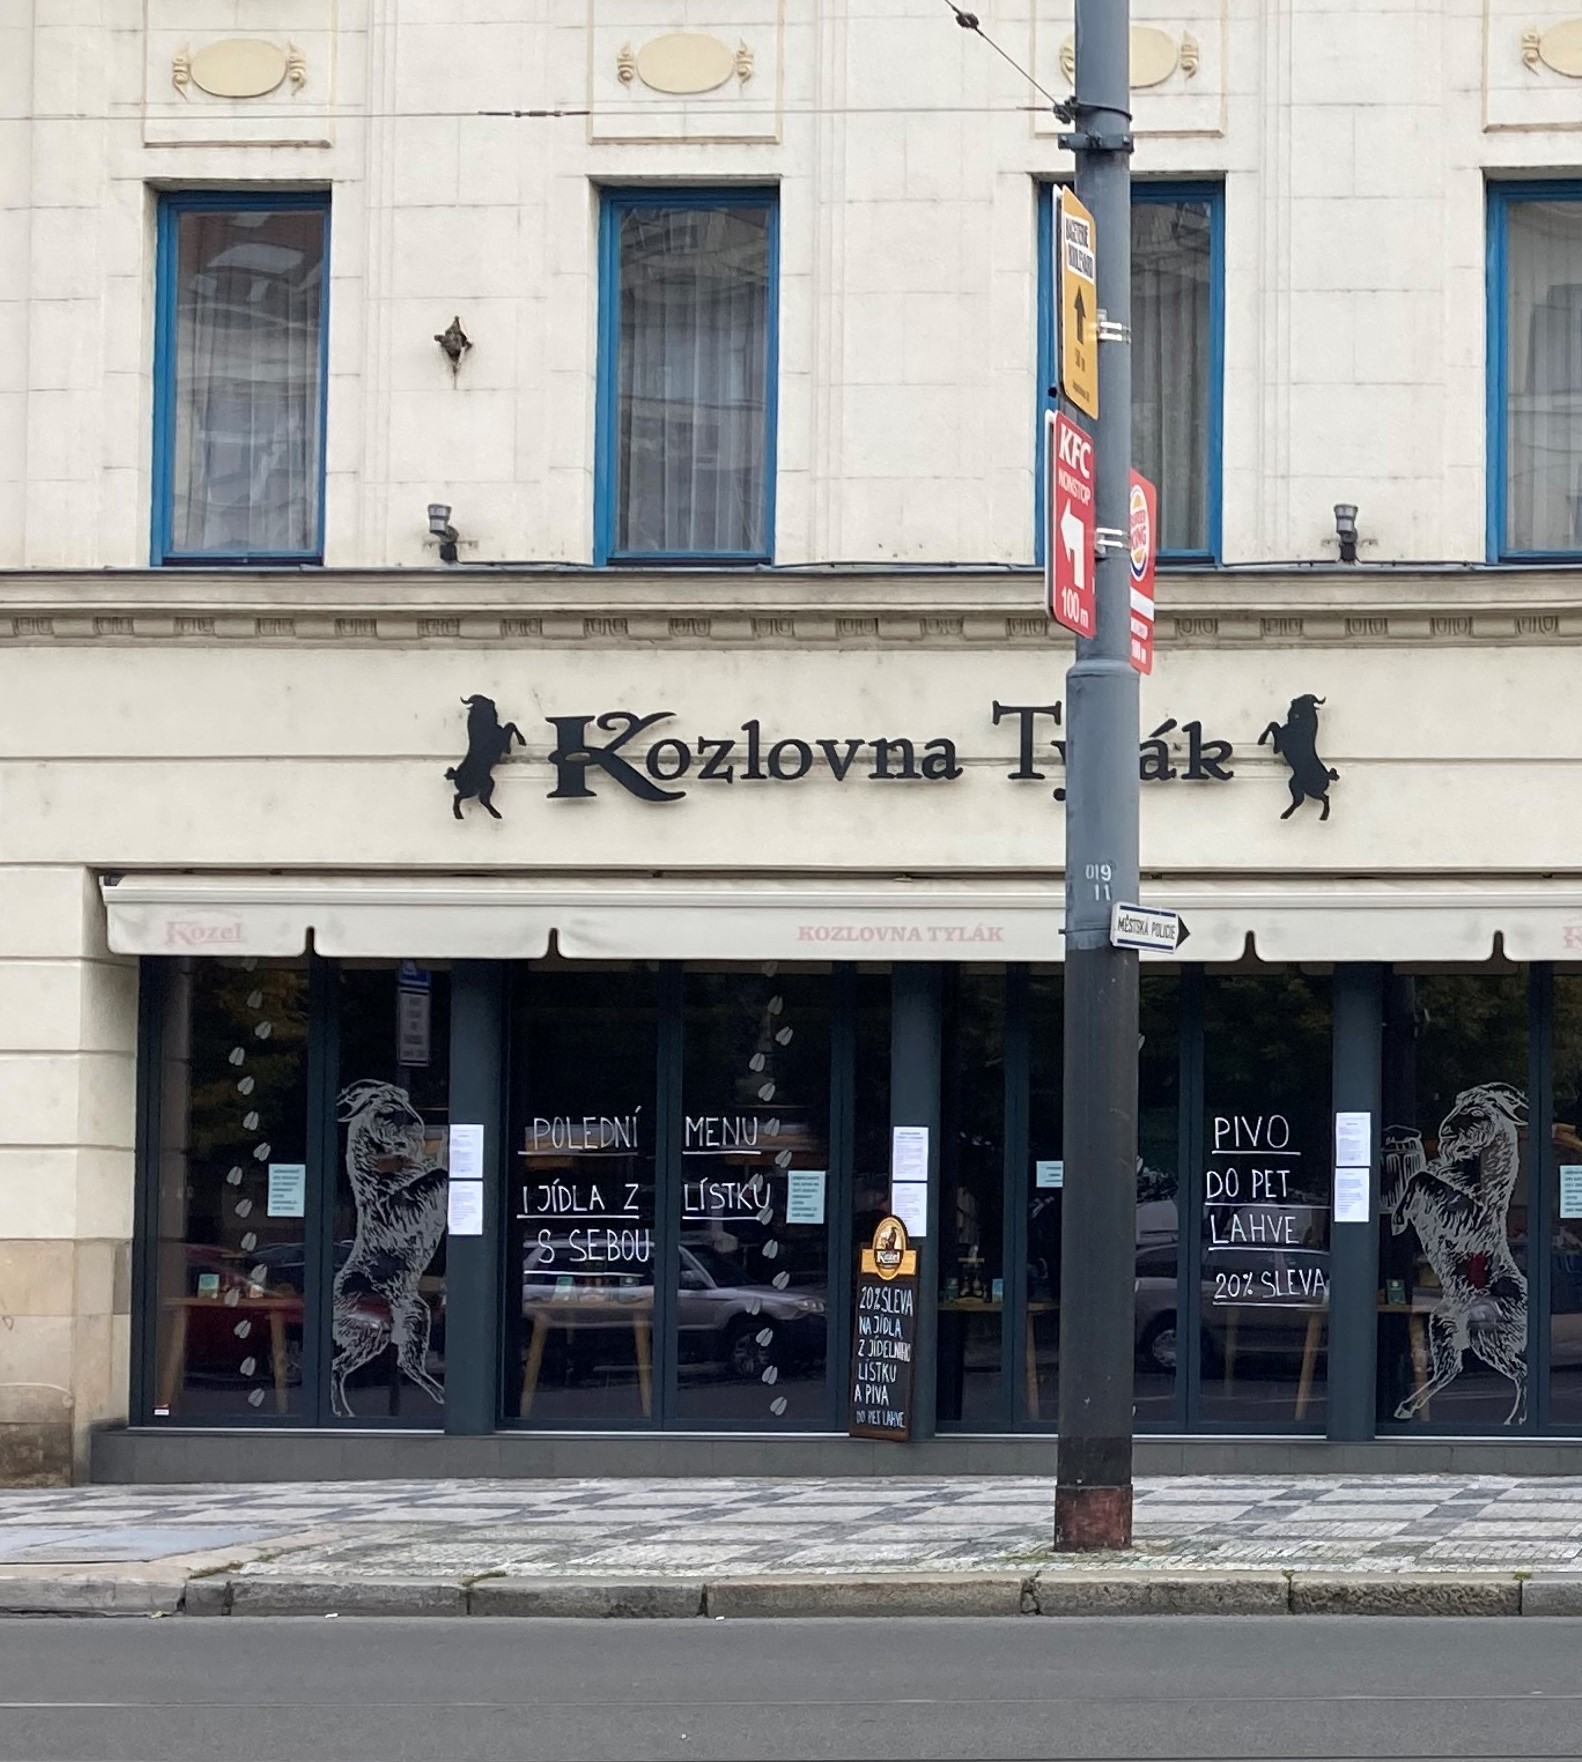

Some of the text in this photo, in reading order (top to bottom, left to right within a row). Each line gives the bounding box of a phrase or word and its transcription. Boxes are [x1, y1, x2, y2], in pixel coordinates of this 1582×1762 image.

[1059, 424, 1091, 479] KFC
[1058, 468, 1091, 506] NONSTOP
[1061, 592, 1089, 629] 100 m
[545, 700, 1235, 801] Kozlovna Ták
[165, 920, 245, 946] Kozel
[797, 922, 1004, 943] KOZLOVNA TYLÁK
[1117, 913, 1176, 940] MĚSTSKÁ POLICIE
[533, 1105, 759, 1150] POLEDNÍ MENU
[1214, 1114, 1290, 1149] PIVO
[522, 1185, 529, 1214] I
[537, 1178, 606, 1213] JÍDLA
[623, 1183, 640, 1210] Z
[683, 1177, 771, 1212] LÍSTKU
[1206, 1167, 1290, 1199] DO PET
[1210, 1213, 1300, 1244] LAHVE
[537, 1228, 650, 1264] S SEBOU
[1214, 1268, 1327, 1299] 20% SLEVA
[859, 1286, 914, 1317] 20% SLEVA
[859, 1313, 902, 1338] NA JÍDLA
[858, 1339, 866, 1357] Z
[858, 1359, 897, 1384] LÍSTKU
[854, 1383, 890, 1406] A PIVA
[856, 1410, 866, 1424] DO
[867, 1410, 881, 1425] PET
